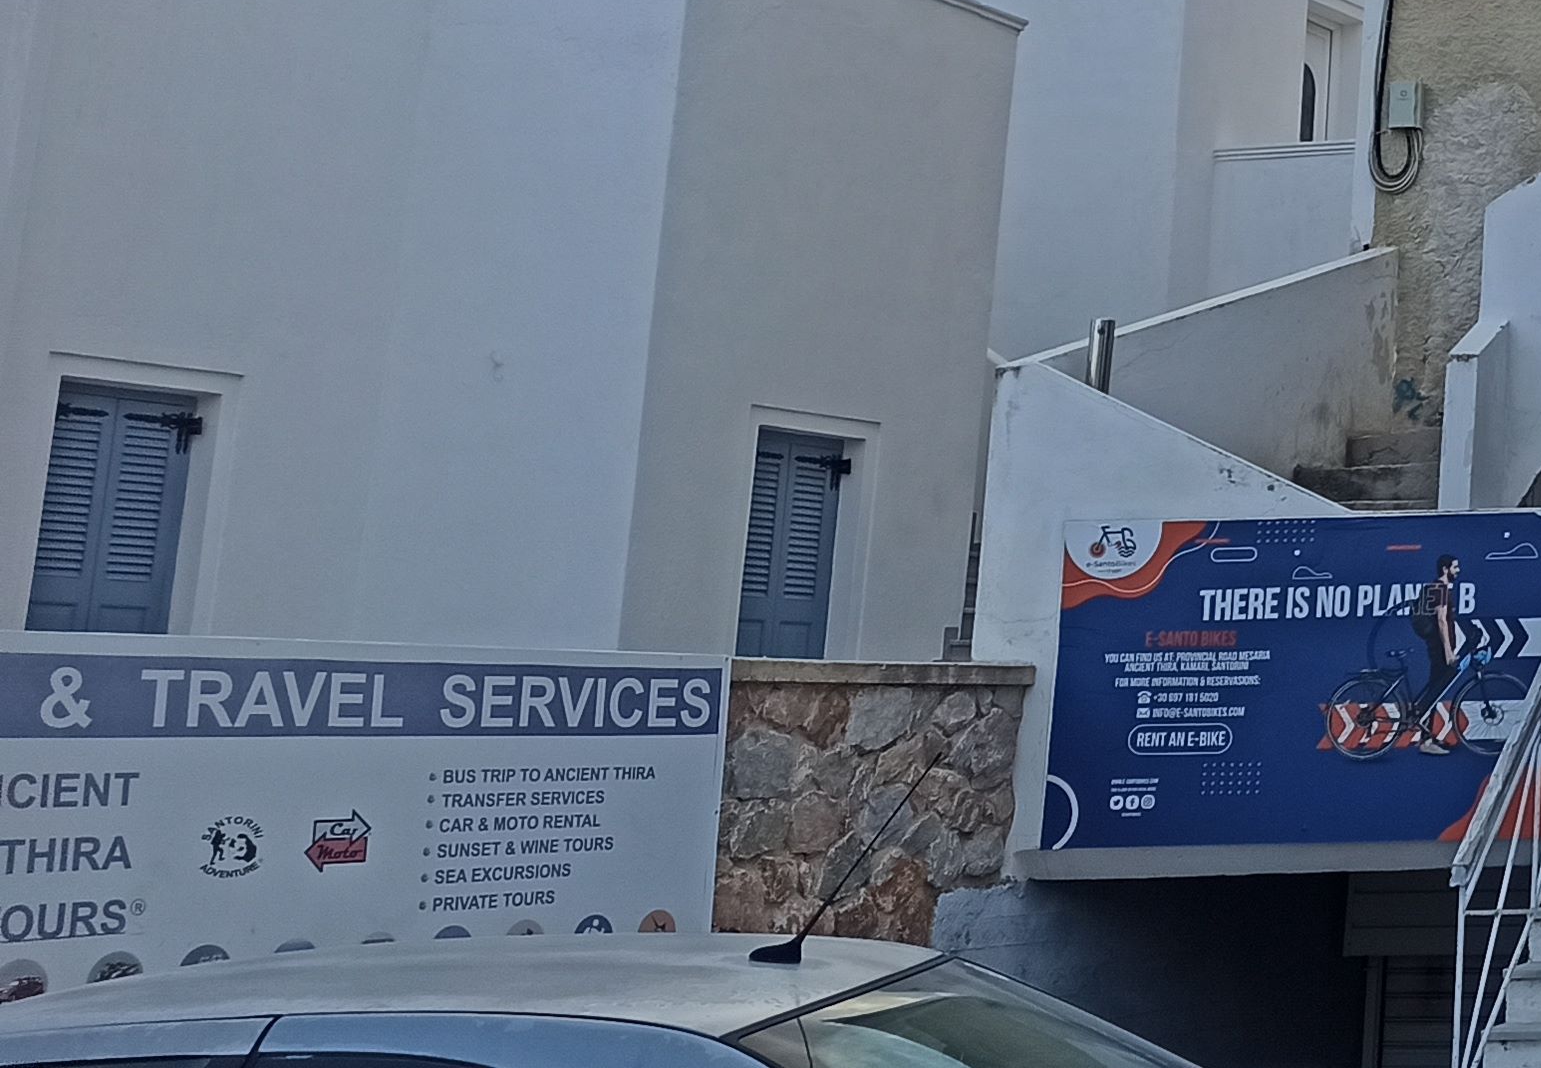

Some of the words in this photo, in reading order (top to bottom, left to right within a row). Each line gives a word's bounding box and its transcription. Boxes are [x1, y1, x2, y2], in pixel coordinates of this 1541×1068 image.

[1200, 586, 1279, 621] THERE
[1285, 585, 1310, 618] IS
[1316, 584, 1351, 618] NO
[1459, 582, 1476, 614] B
[1145, 631, 1199, 648] E-SANTO
[1201, 630, 1237, 646] BIKES
[1105, 653, 1119, 663] YOU
[1120, 653, 1135, 662] CAN
[1136, 652, 1152, 662] FIND
[1153, 652, 1163, 662] US
[1176, 651, 1217, 662] PROVINCIAL
[1218, 651, 1238, 661] ROAD
[1238, 650, 1271, 660] MESARIA
[1124, 662, 1155, 672] ANCIENT
[1115, 678, 1128, 687] FOR
[1130, 677, 1150, 687] MORE
[1151, 676, 1199, 687] INFORMATION
[40, 667, 93, 730] &
[141, 669, 403, 728] TRAVEL
[440, 673, 711, 729] SERVICES
[1136, 732, 1167, 747] RENT
[1168, 731, 1185, 747] AN
[1187, 731, 1226, 746] E-BIKE
[443, 769, 476, 784] BUS
[481, 768, 515, 783] TRIP
[520, 768, 541, 782] TO
[543, 767, 609, 782] ANCIENT
[613, 766, 656, 780] THIRA
[0, 772, 141, 809] CIENT
[442, 792, 526, 808] TRANSFER
[530, 790, 605, 806] SERVICES
[201, 816, 264, 842] SANTORINI
[330, 823, 357, 837] Car
[439, 818, 473, 833] CAR
[478, 817, 489, 832] &
[494, 816, 539, 831] MOTO
[543, 814, 601, 829] RENTAL
[0, 836, 132, 875] THIRA
[316, 844, 363, 860] Moto
[437, 842, 501, 858] SUNSET
[505, 840, 516, 855] &
[520, 838, 559, 854] WINE
[563, 836, 614, 852] TOURS
[200, 861, 261, 879] ADVENTURE
[434, 869, 467, 884] SEA
[471, 863, 572, 883] EXCURSIONS
[432, 894, 498, 912] PRIVATE
[503, 890, 555, 907] TOURS
